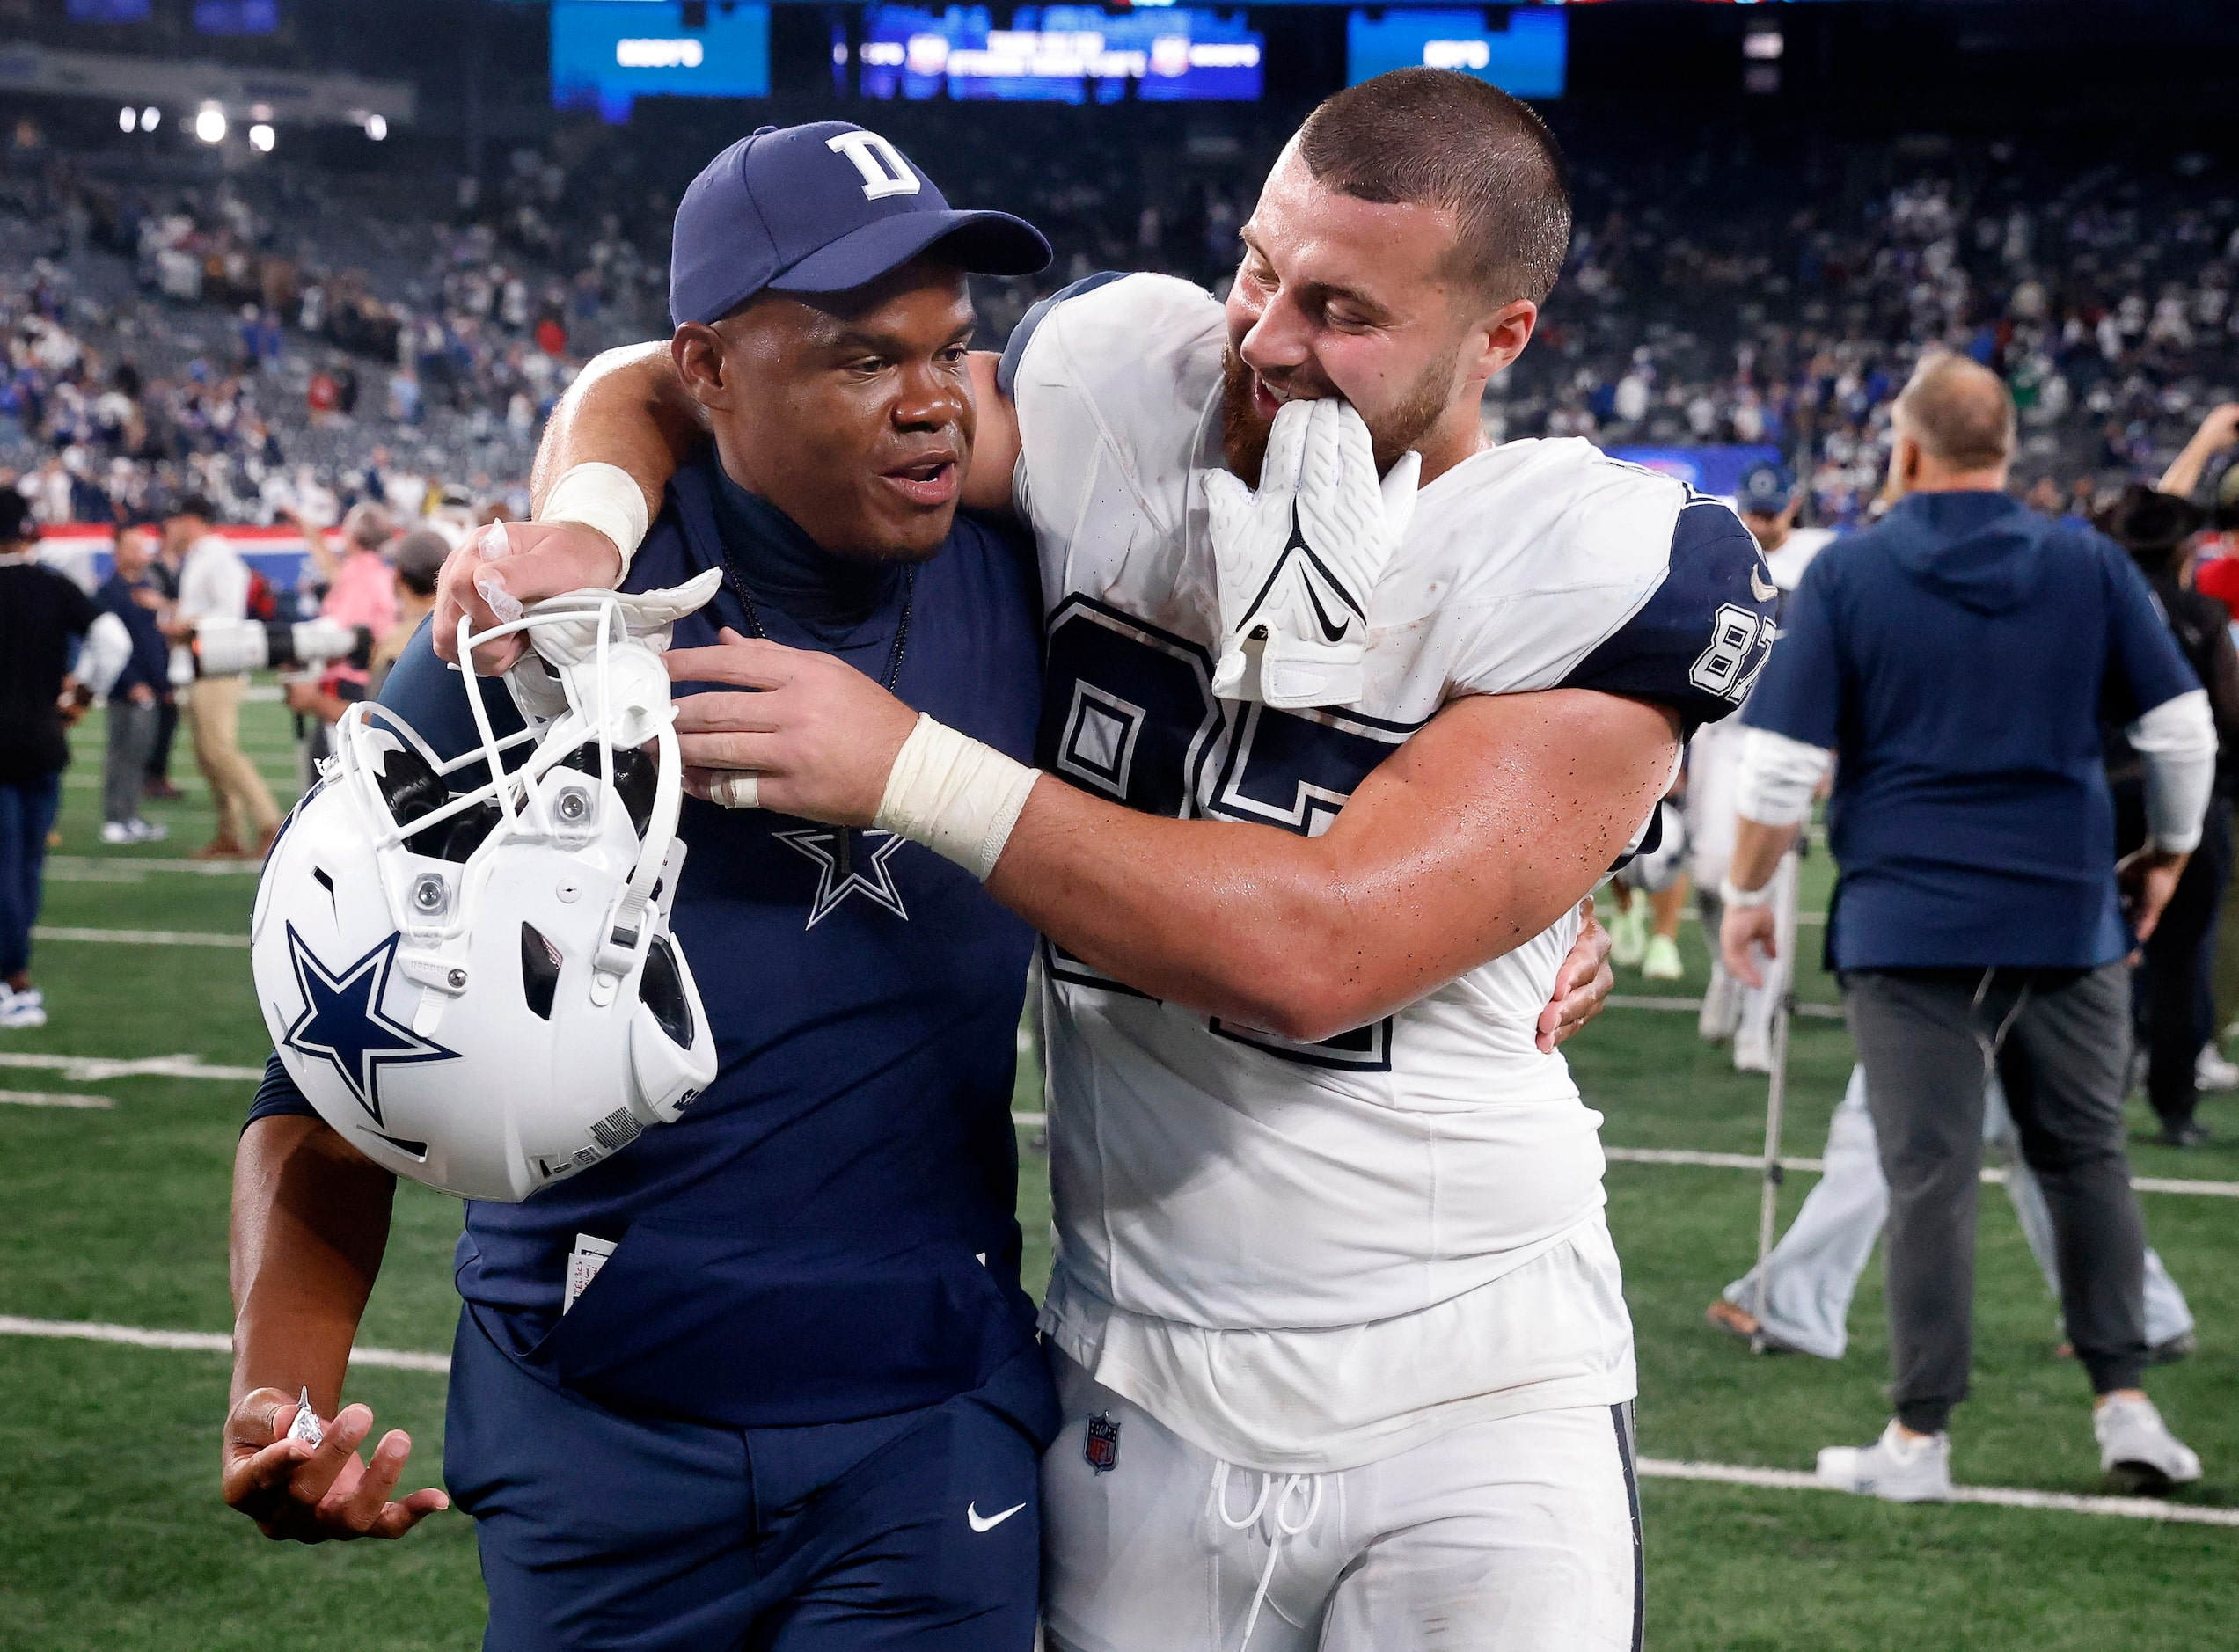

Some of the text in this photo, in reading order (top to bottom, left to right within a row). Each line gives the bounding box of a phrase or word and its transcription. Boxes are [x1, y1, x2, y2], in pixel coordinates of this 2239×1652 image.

[825, 130, 921, 201] D
[1688, 603, 1777, 705] 87
[1088, 1437, 1115, 1464] NFL
